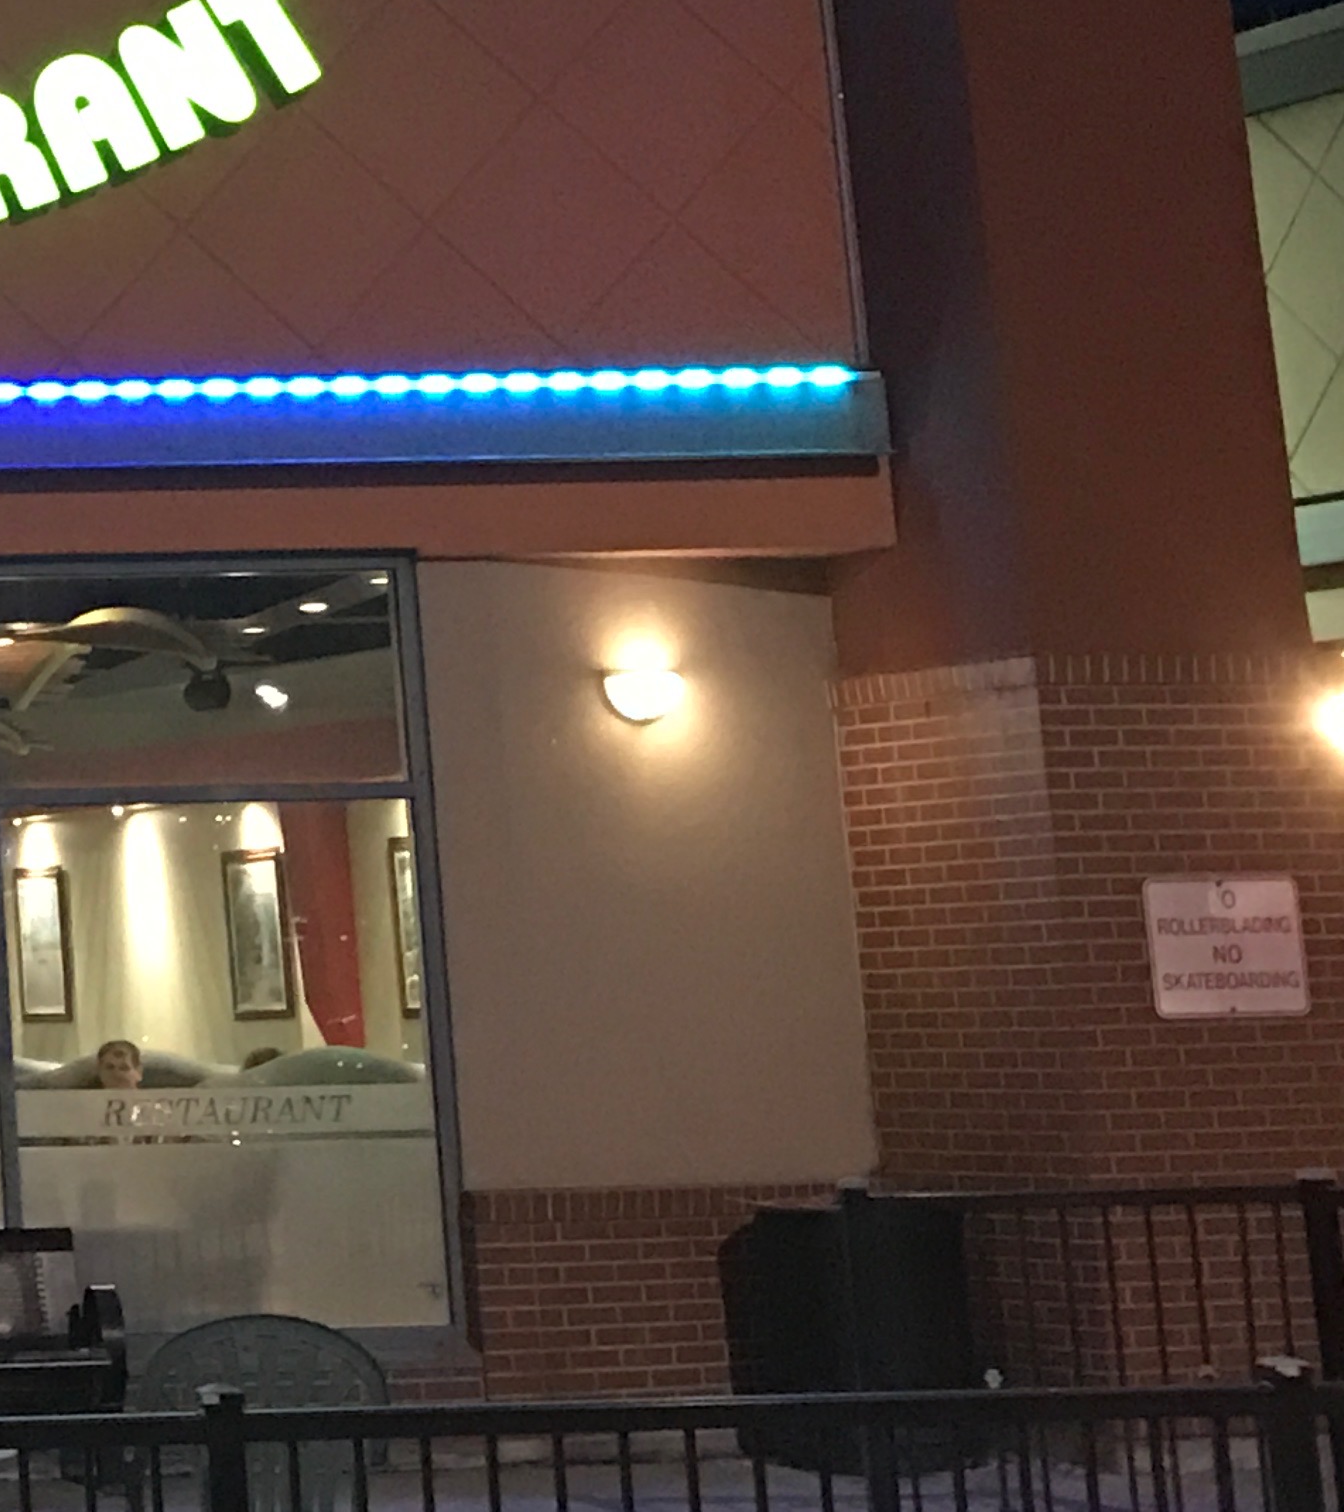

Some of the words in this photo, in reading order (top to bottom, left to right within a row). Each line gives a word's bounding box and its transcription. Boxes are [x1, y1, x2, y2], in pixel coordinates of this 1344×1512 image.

[1157, 916, 1292, 936] ROLLERBLADING
[1213, 944, 1244, 965] NO
[1162, 971, 1300, 991] SKATEBOARDING
[101, 1093, 353, 1128] RESTAURANT
